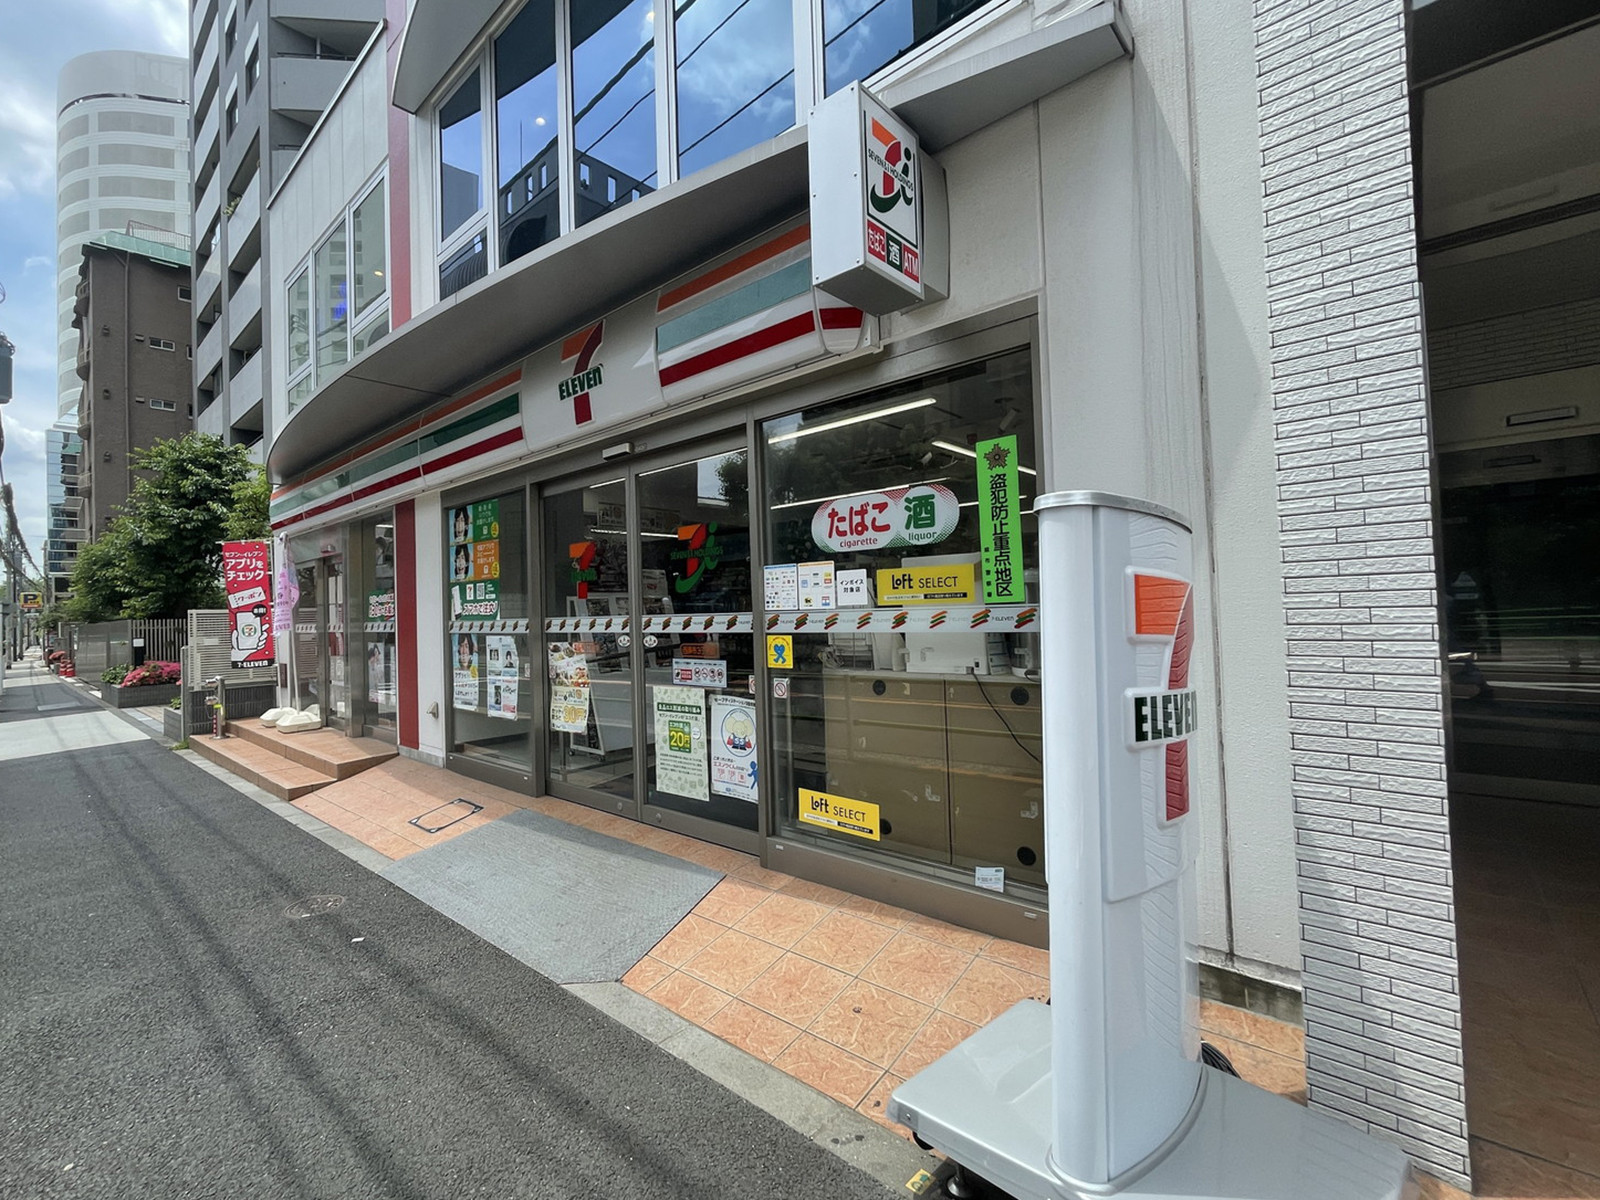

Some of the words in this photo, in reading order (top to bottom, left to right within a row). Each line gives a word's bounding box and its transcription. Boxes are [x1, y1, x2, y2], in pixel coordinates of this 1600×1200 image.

[888, 240, 900, 266] 酒
[903, 251, 918, 275] ATM
[828, 501, 891, 539] たばこ
[904, 493, 936, 530] 酒
[908, 530, 938, 541] liquor
[989, 473, 1014, 597] 盗犯防止重点地区
[839, 536, 878, 548] cigarette
[225, 558, 264, 570] アプリを
[227, 569, 265, 581] チェック
[840, 578, 865, 586] インボイス
[918, 576, 958, 588] SELECT
[832, 805, 867, 823] SELECT
